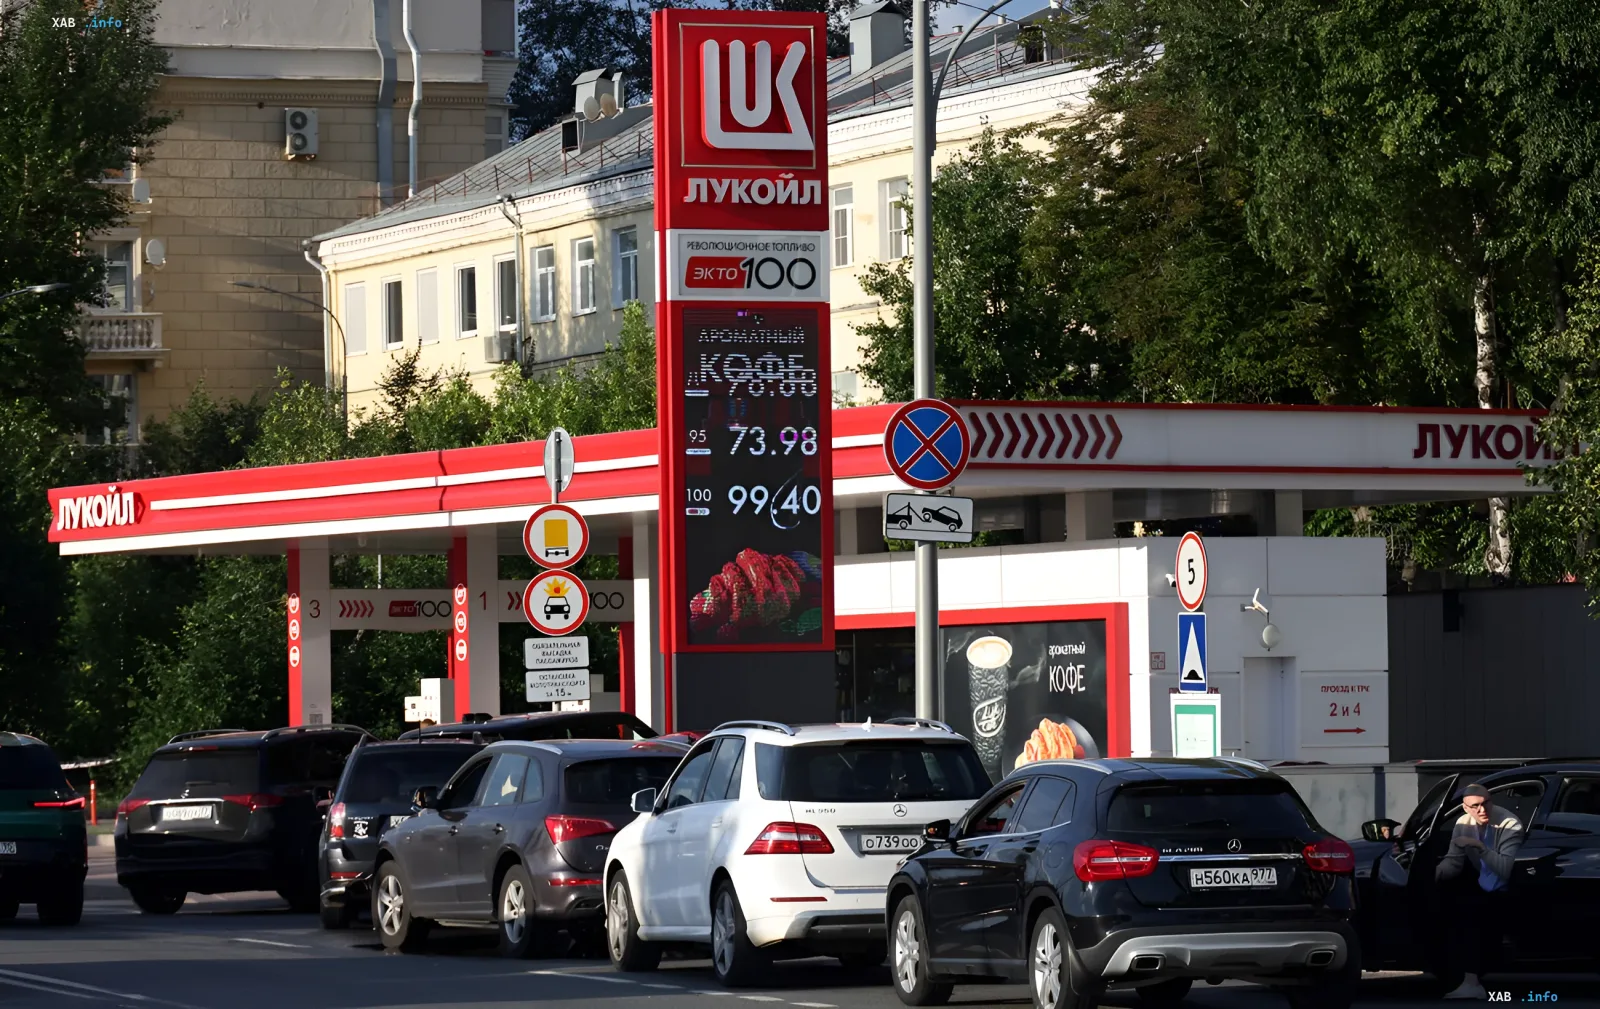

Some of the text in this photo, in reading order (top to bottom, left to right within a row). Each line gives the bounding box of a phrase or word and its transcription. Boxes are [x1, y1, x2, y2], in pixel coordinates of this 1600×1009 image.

[683, 172, 822, 205] ЛУКОЙЛ
[686, 241, 816, 252] РЕВОЛЮЦИОННОЕ ТОПЛИВО
[693, 256, 817, 290] ЭКТО 100
[689, 426, 818, 456] 95 73.98
[56, 484, 135, 532] ЛУКОЙЛ
[686, 484, 822, 515] 100 99.40
[1187, 558, 1196, 586] 5
[309, 599, 321, 619] 3
[414, 600, 452, 618] 100
[479, 590, 487, 611] 1
[555, 688, 566, 696] 15
[1049, 662, 1086, 694] КОФЕ
[1330, 702, 1338, 716] 2
[1353, 702, 1361, 716] 4
